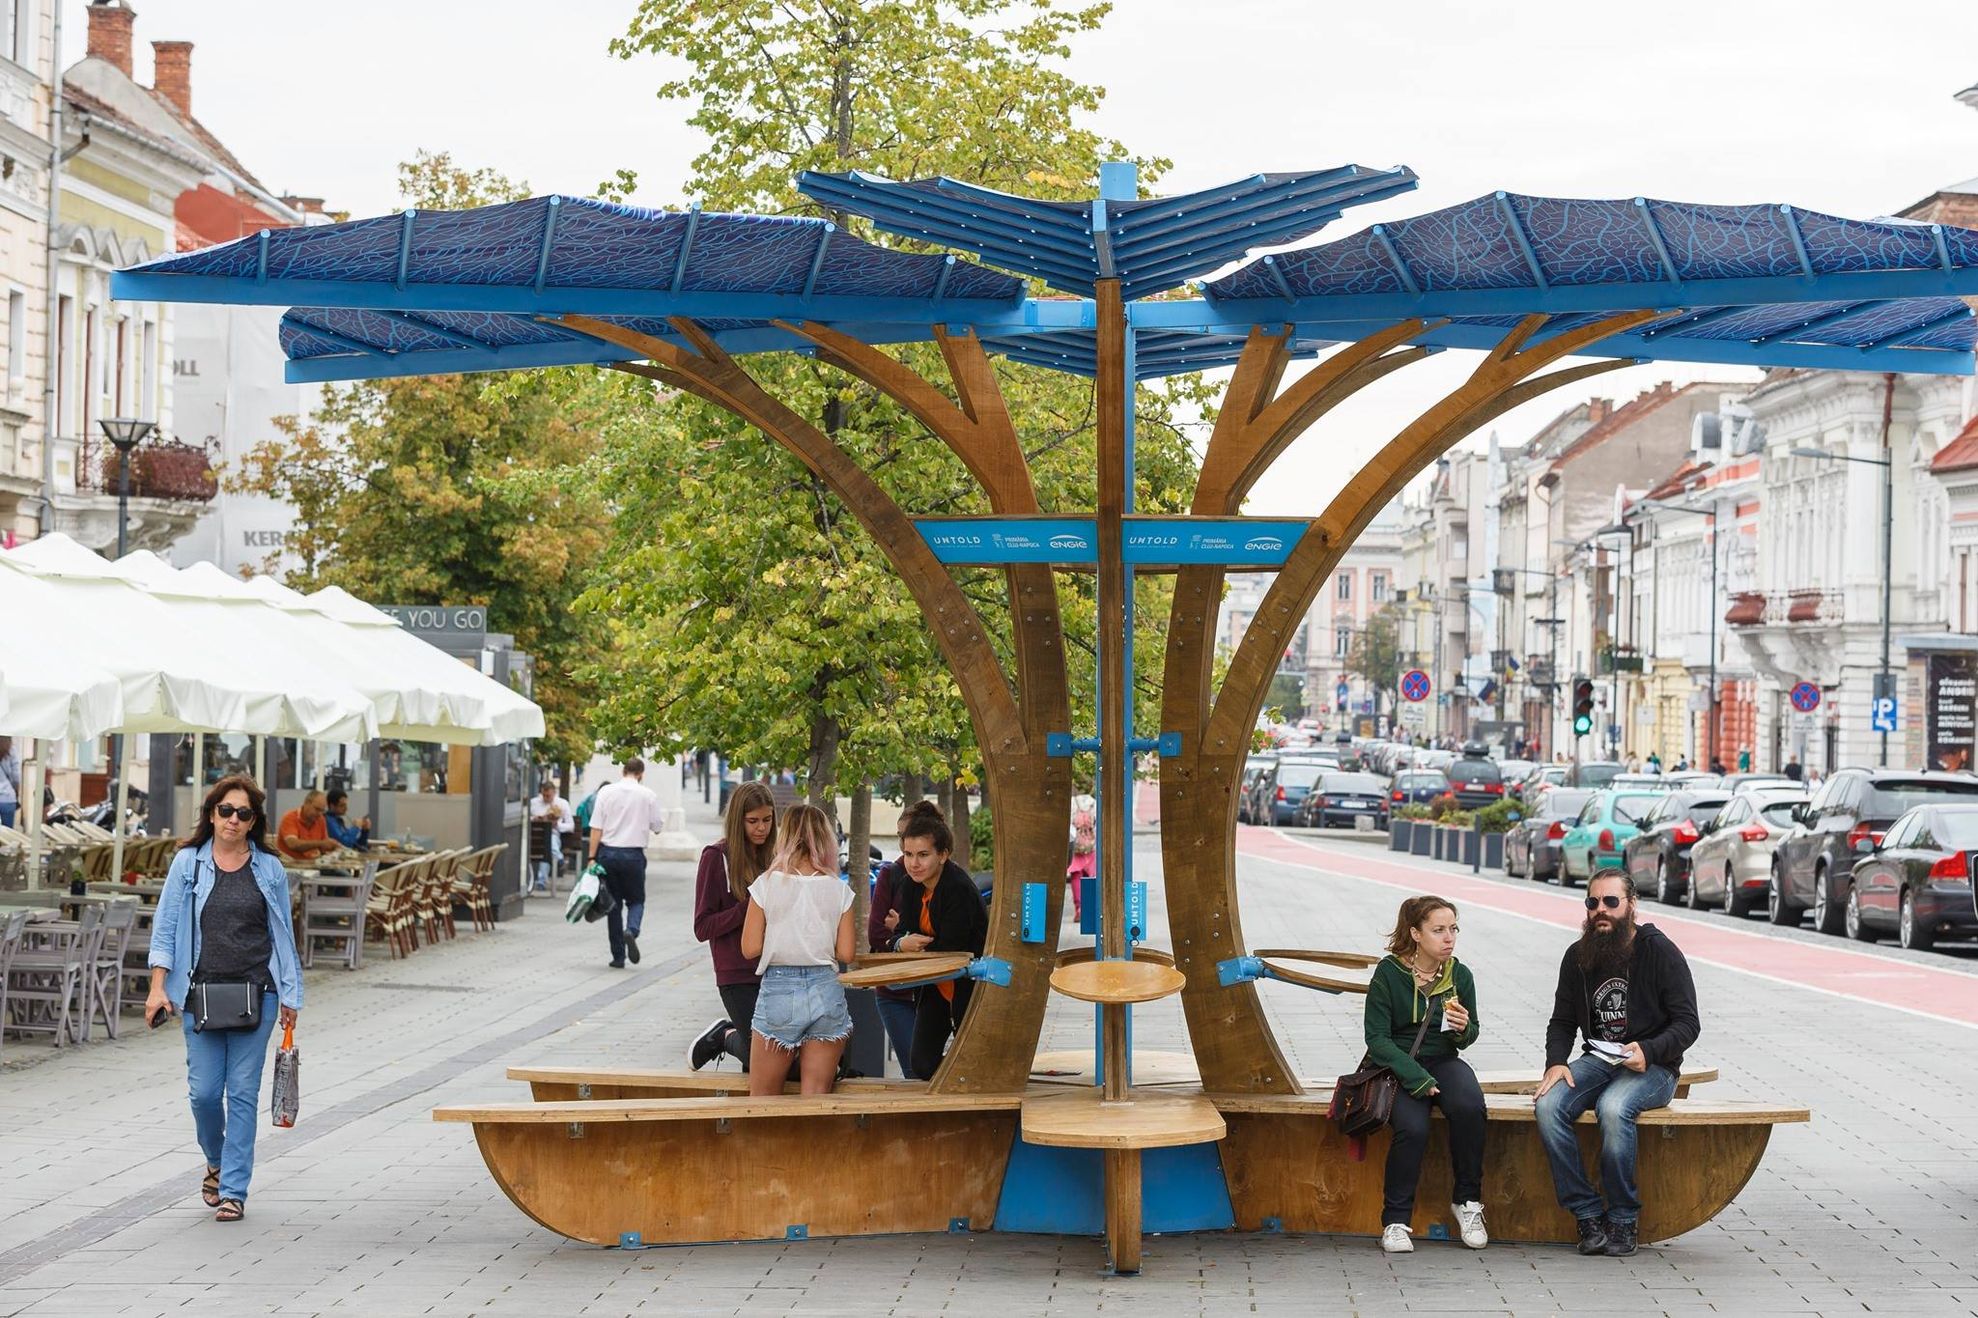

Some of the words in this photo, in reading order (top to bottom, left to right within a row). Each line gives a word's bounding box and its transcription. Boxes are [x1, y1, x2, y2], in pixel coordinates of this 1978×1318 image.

[933, 536, 982, 545] UNTOLD
[1128, 536, 1178, 545] UNTOLD
[408, 609, 446, 628] YOU
[454, 609, 483, 629] GO
[1878, 698, 1894, 719] P
[1131, 882, 1139, 926] UNTOLD
